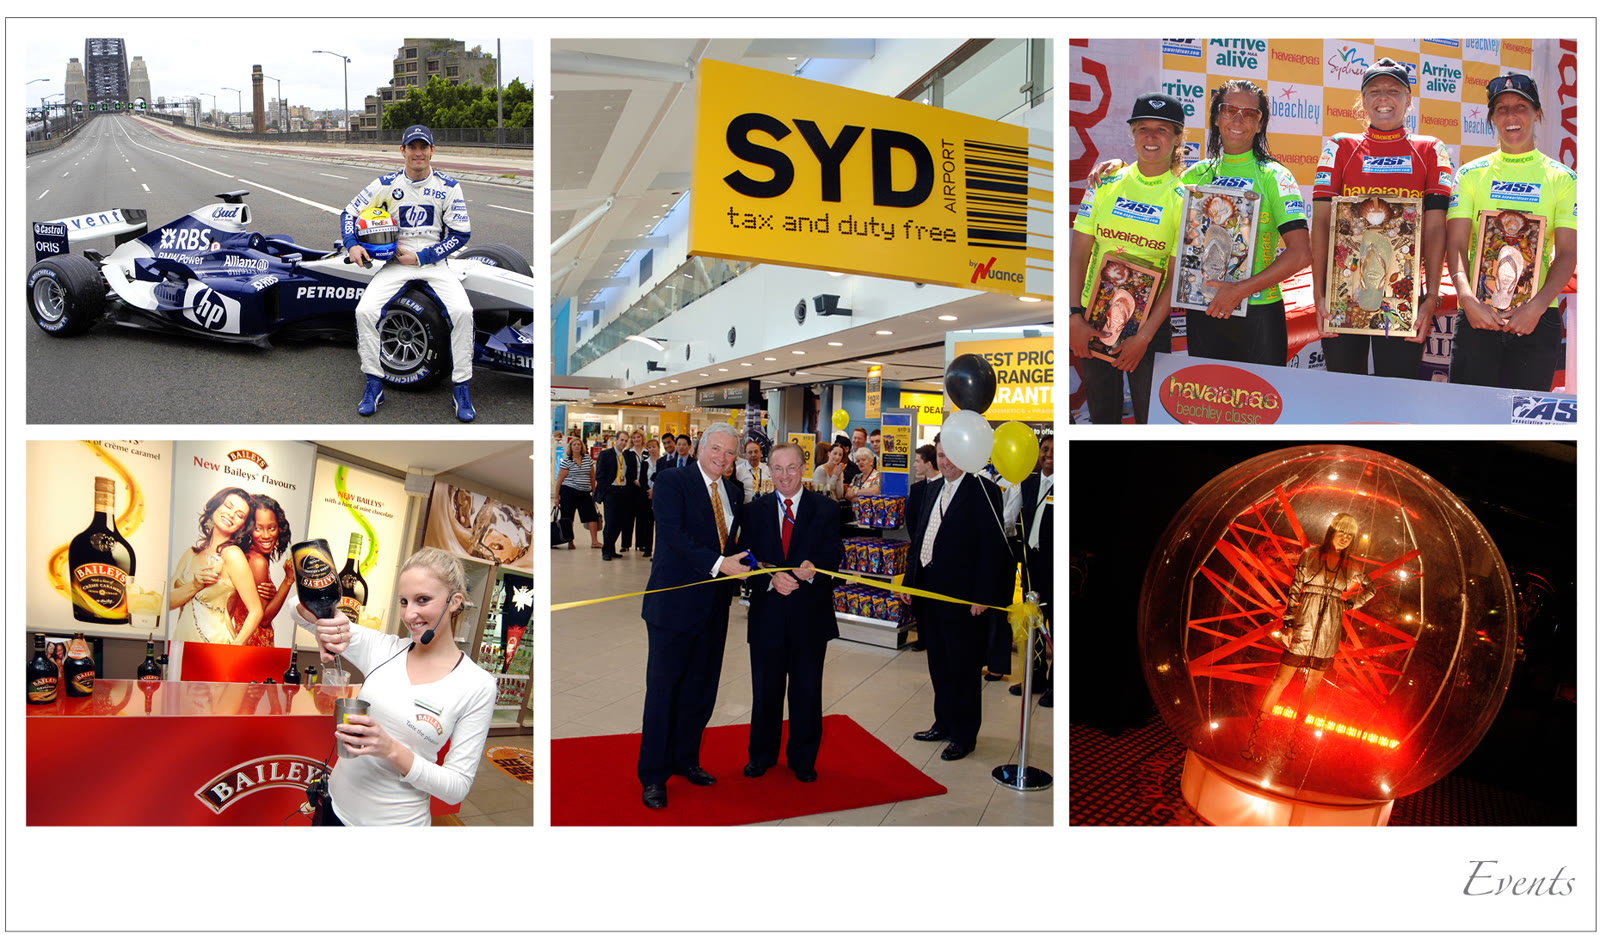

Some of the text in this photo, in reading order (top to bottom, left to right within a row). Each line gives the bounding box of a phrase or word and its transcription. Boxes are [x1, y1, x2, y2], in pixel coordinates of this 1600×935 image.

[1210, 38, 1265, 51] Arrive
[1216, 50, 1258, 69] alive
[1271, 48, 1320, 65] havaianas
[1422, 61, 1462, 79] Arrive
[1426, 78, 1456, 93] alive
[1272, 96, 1320, 124] beachley
[1421, 114, 1458, 126] havaianas
[722, 112, 955, 214] SYD AIRPORT
[212, 206, 240, 219] Bud
[409, 206, 425, 228] hp
[40, 223, 64, 235] Castrol
[727, 207, 957, 243] tax and duty free
[176, 229, 211, 251] RBS
[443, 236, 460, 252] RBS
[1096, 224, 1166, 251] havaianas
[36, 241, 60, 253] ORIS
[178, 254, 204, 266] Power
[224, 255, 257, 268] Allianz
[969, 257, 1025, 284] by Nuance
[261, 275, 279, 290] RBS
[196, 288, 224, 329] hp
[1169, 376, 1278, 409] havaianas
[1176, 401, 1262, 424] beachley classic
[104, 442, 129, 453] crème
[131, 448, 161, 461] caramel
[229, 450, 267, 469] BAILEYS
[193, 456, 296, 491] New Baileys flavours
[325, 497, 337, 505] with
[359, 506, 372, 514] mint
[372, 508, 394, 519] chocolate
[338, 491, 383, 508] NEW BAILEYS
[77, 565, 127, 582] BAILEYS
[303, 572, 336, 587] BAILEYS
[406, 719, 417, 731] Taste
[416, 728, 425, 737] the
[418, 714, 442, 734] BAILEYS
[494, 758, 526, 767] SIZE
